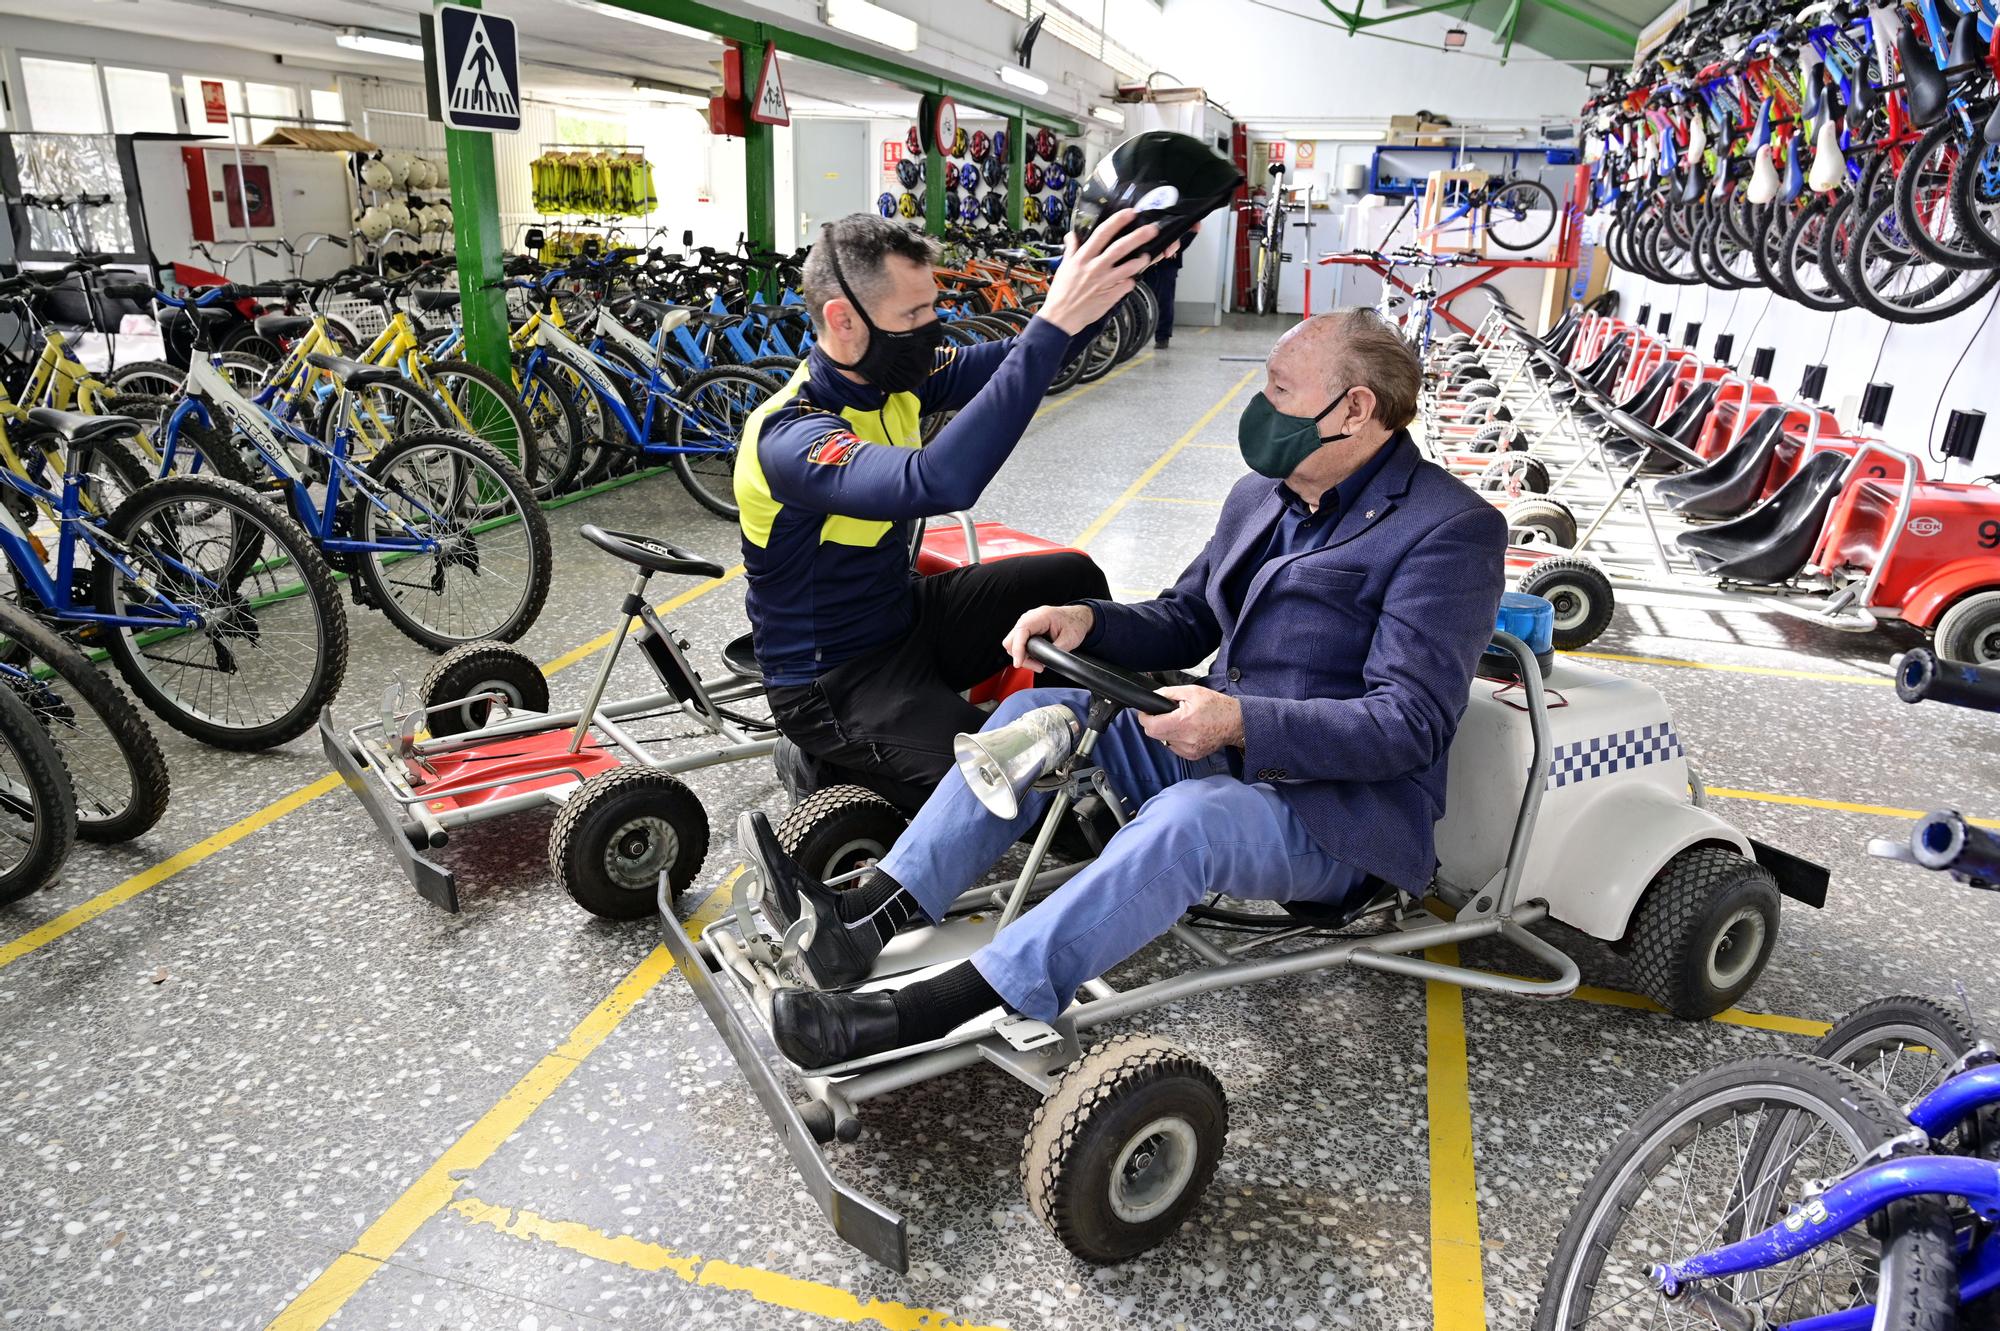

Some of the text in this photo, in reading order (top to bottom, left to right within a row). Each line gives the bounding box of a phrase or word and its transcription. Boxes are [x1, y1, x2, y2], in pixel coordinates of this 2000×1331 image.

[563, 347, 612, 390] OREGON
[222, 400, 283, 460] OREGON
[1977, 519, 2000, 550] 9
